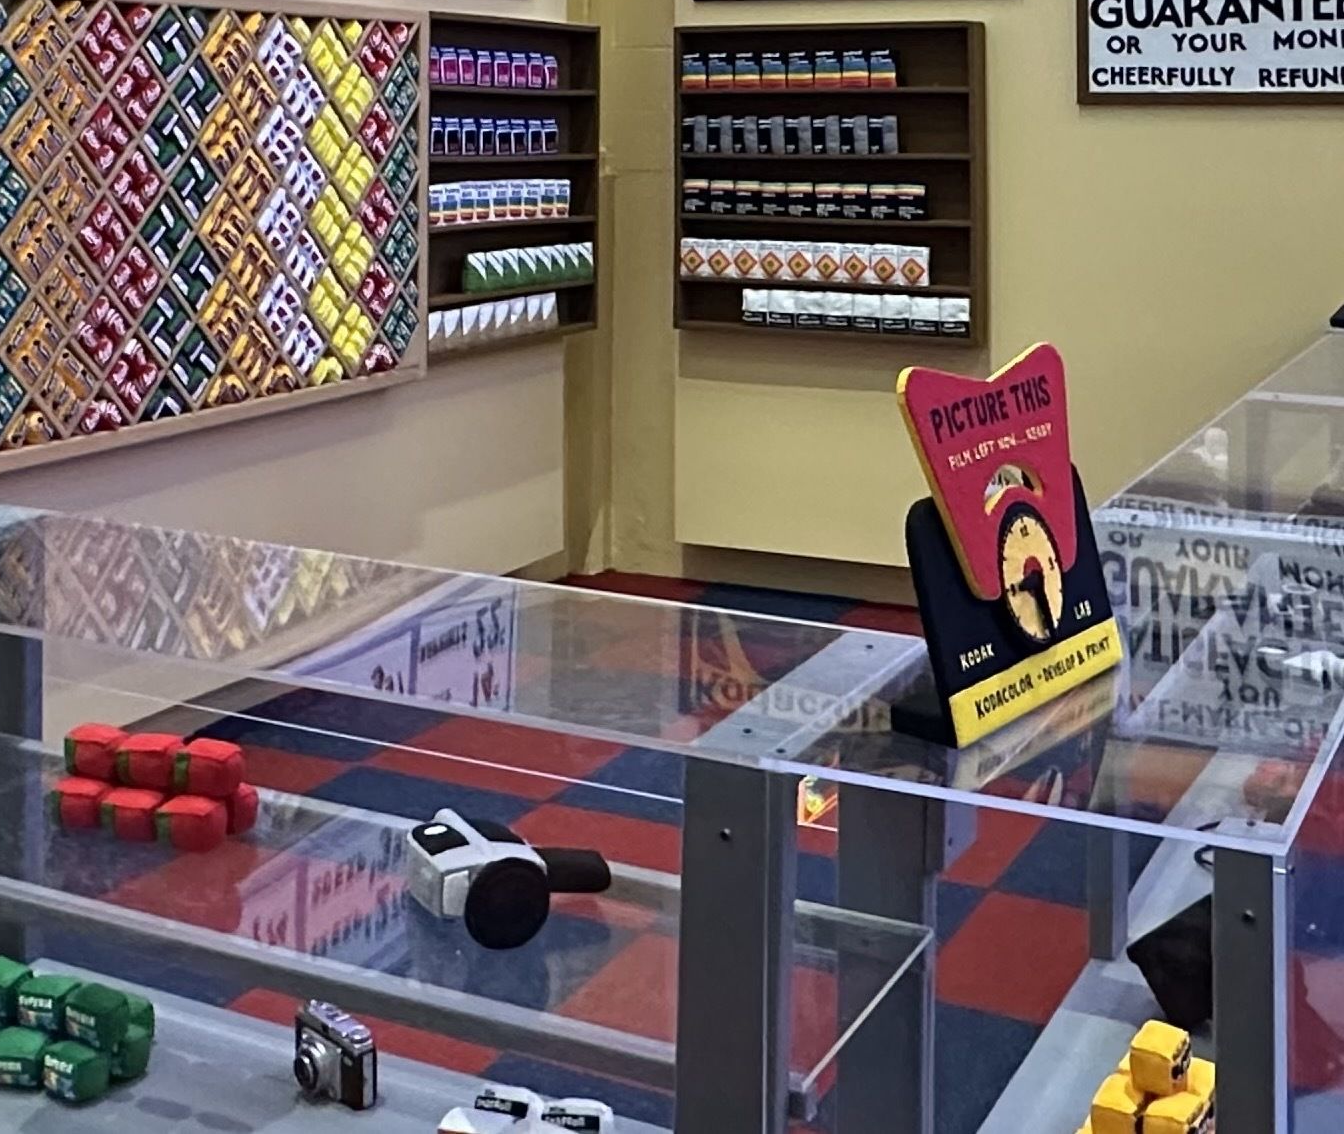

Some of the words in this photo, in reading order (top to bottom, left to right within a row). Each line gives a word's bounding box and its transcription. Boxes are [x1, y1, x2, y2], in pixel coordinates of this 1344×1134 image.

[1105, 35, 1143, 54] OR
[1171, 32, 1248, 53] YOUR
[1091, 66, 1236, 87] CHEERFULLY
[929, 388, 1010, 445] PICTURE
[1009, 374, 1053, 414] THIS
[947, 449, 974, 472] FILM
[973, 438, 996, 461] LEFT
[1073, 599, 1093, 621] LAB
[959, 642, 996, 672] KODAK
[974, 672, 1035, 721] KODACOLOR
[1042, 654, 1077, 684] DEVELOP
[1085, 635, 1112, 660] PRINT
